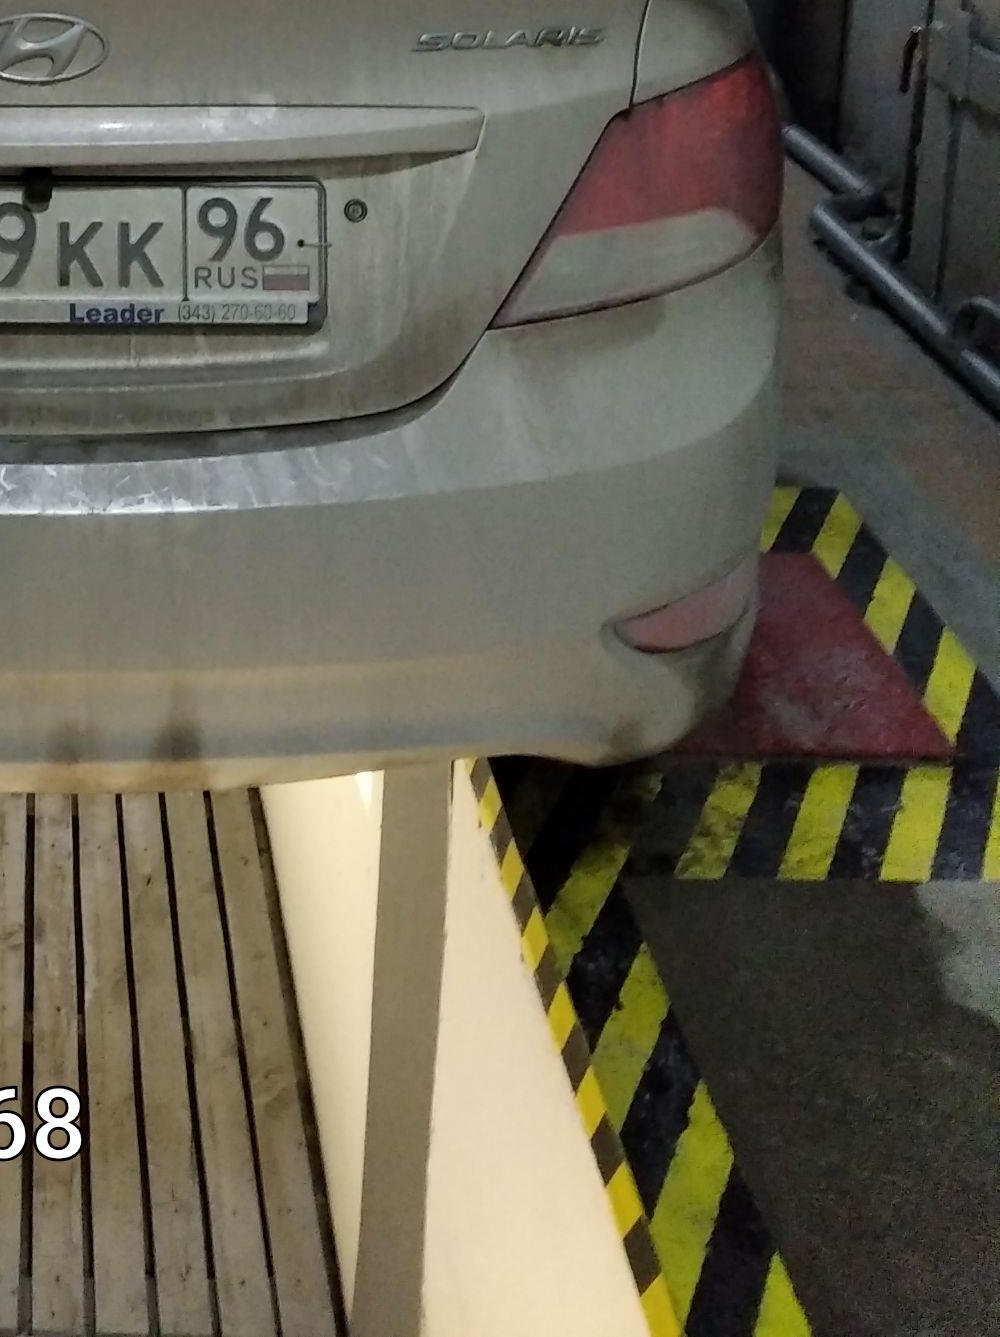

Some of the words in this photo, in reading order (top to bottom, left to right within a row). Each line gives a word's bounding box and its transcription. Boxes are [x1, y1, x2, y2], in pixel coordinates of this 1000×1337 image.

[412, 26, 605, 52] SOLARIS
[198, 196, 286, 262] 96
[193, 266, 259, 290] RUS
[69, 302, 165, 324] Leader
[177, 303, 216, 322] (343)
